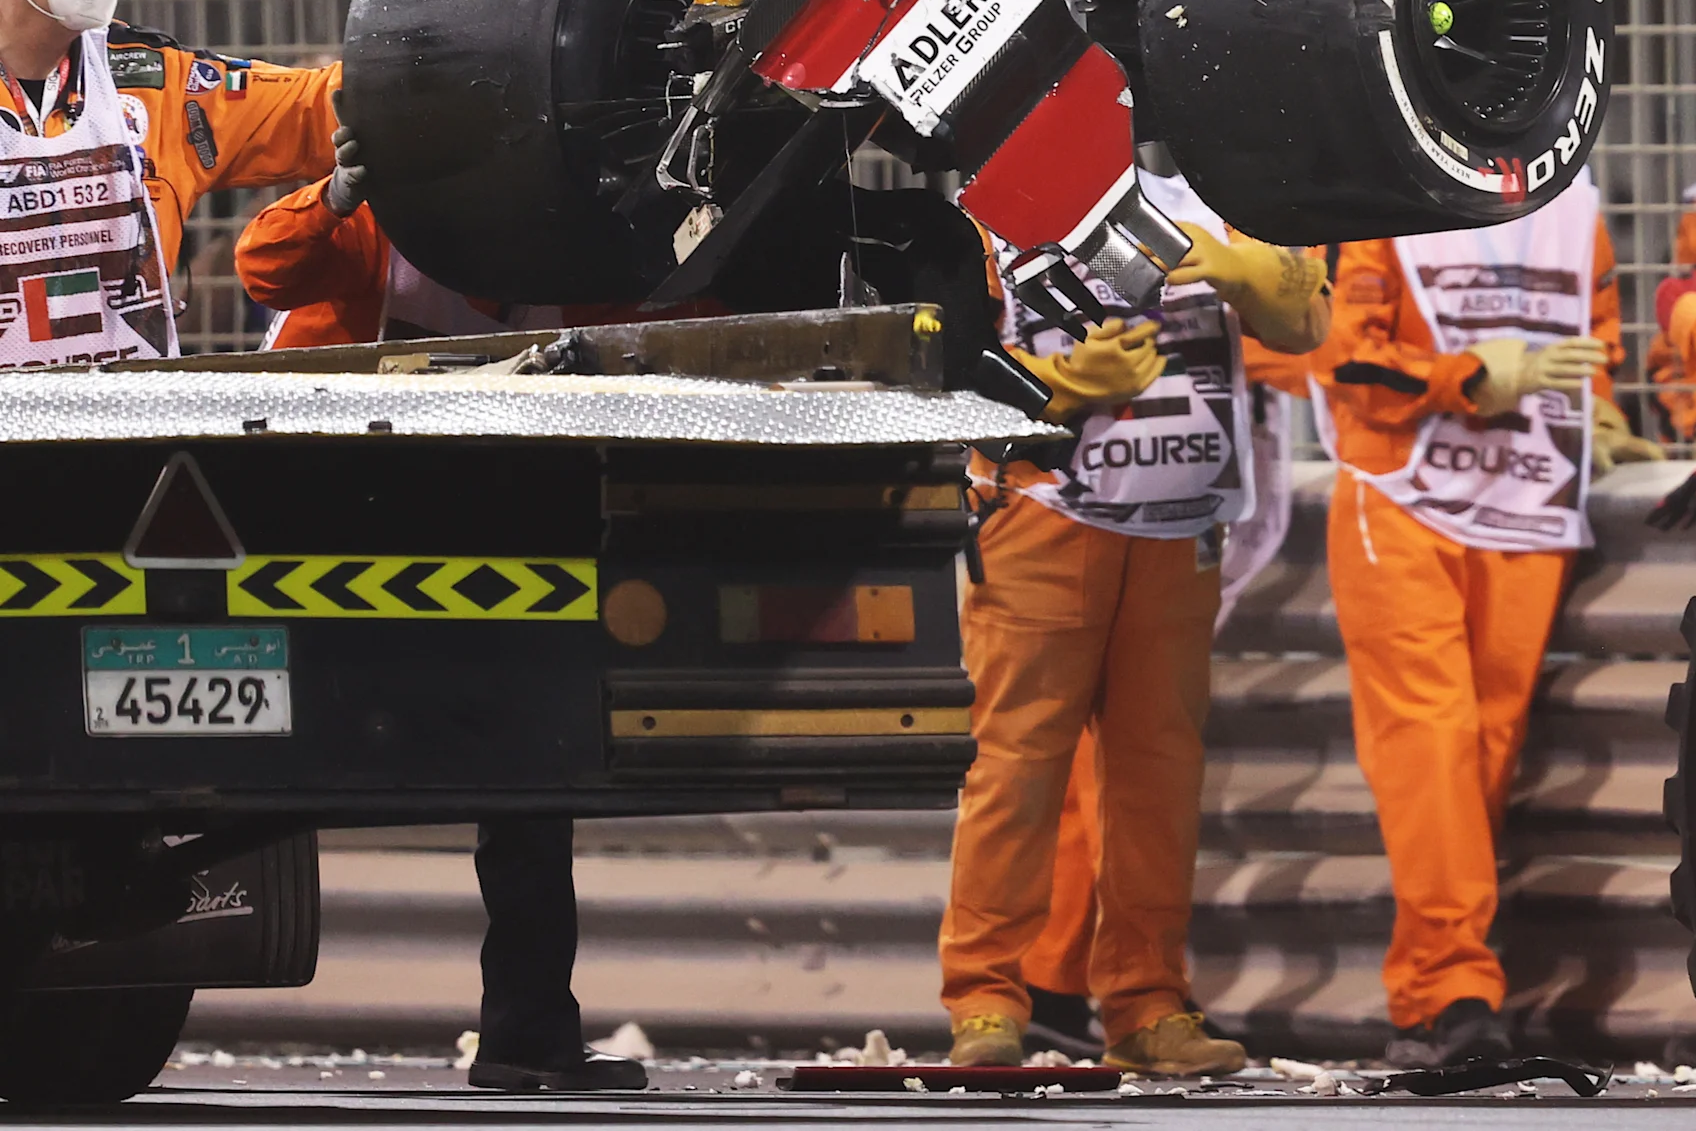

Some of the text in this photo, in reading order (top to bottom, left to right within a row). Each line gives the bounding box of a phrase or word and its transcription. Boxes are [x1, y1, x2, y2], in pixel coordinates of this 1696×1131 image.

[110, 52, 147, 61] AIRCREW
[910, 2, 1001, 107] PELZER GROUP
[1526, 26, 1605, 193] ZERO
[25, 165, 47, 179] FIA
[8, 182, 109, 213] ABD1 532
[60, 229, 114, 249] PERSONNEL
[1082, 433, 1221, 471] COURSE
[1426, 442, 1552, 483] COURSE
[177, 633, 195, 665] 1
[115, 676, 263, 724] 45429
